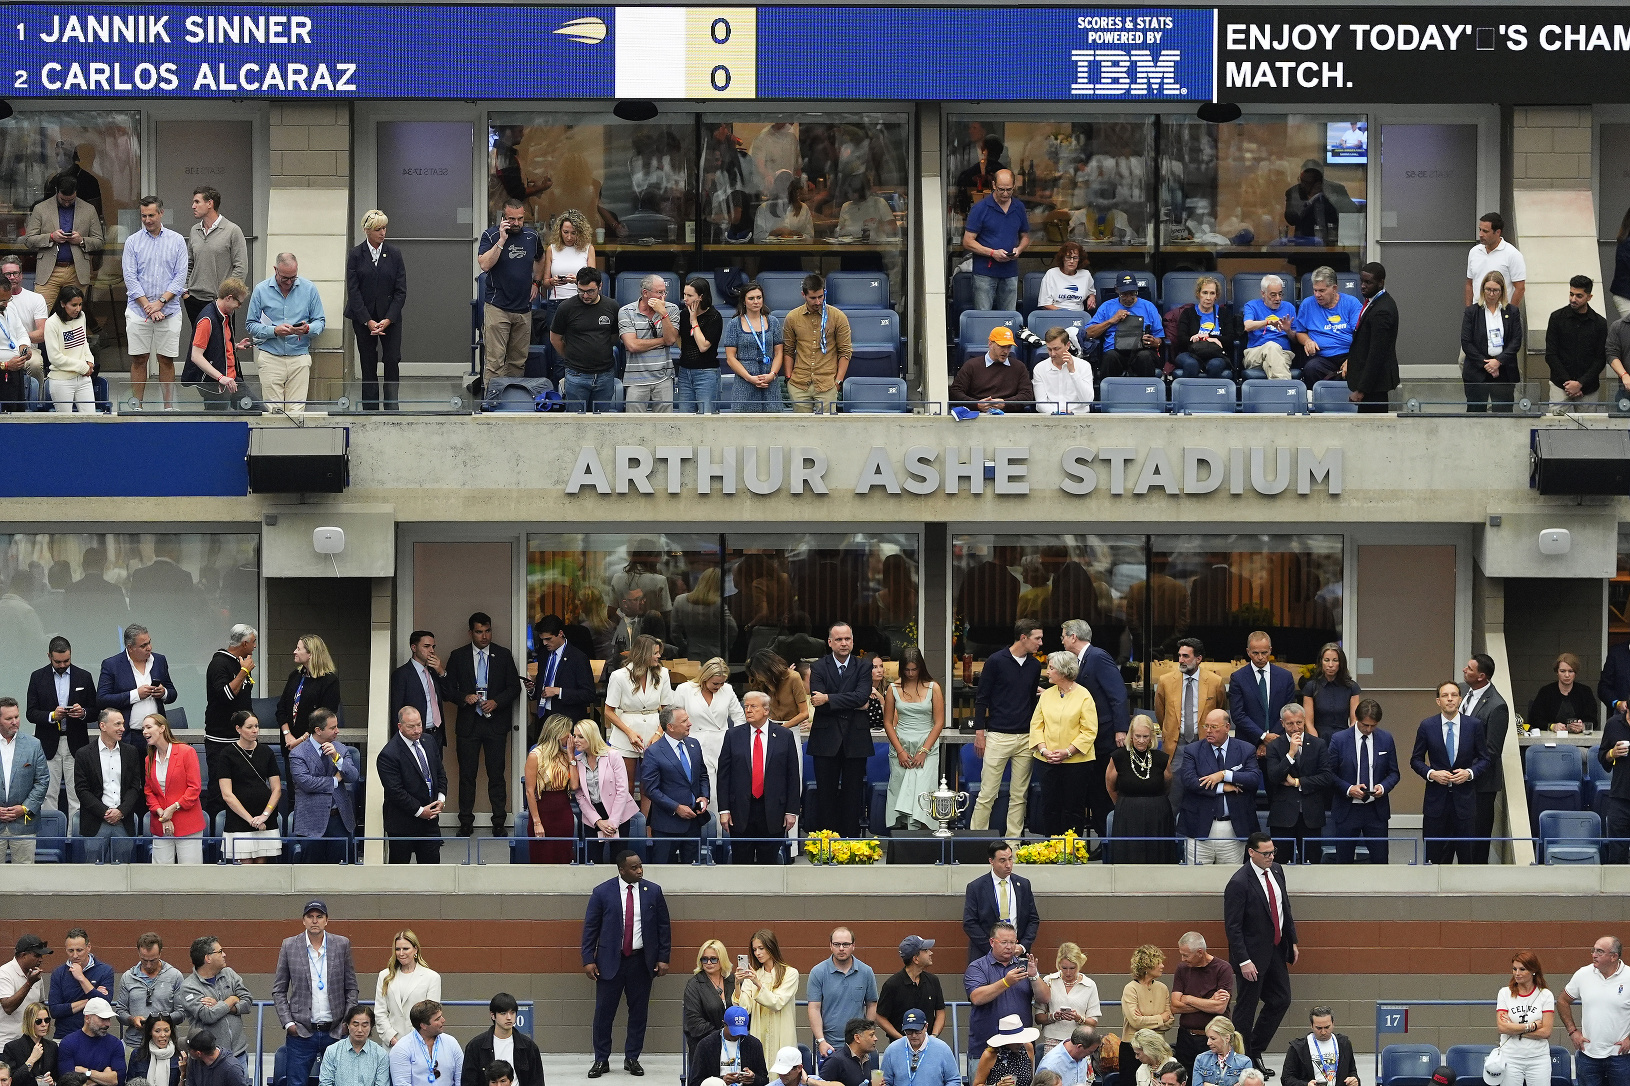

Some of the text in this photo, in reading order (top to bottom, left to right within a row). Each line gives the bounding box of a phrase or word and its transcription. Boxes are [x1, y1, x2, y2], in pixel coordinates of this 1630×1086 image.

[17, 15, 312, 44] 1 JANNIK SINNER
[710, 17, 731, 44] 0
[1077, 16, 1174, 29] SCORES & STATS
[1088, 31, 1163, 44] POWERED BY
[1226, 24, 1341, 50] ENJOY
[14, 62, 357, 91] 2 CARLOS ALCARAZ
[710, 65, 731, 92] 0
[1226, 61, 1354, 88] MATCH.
[565, 445, 1342, 496] ARTHUR ASHE STADIUM
[1385, 1014, 1401, 1027] 17
